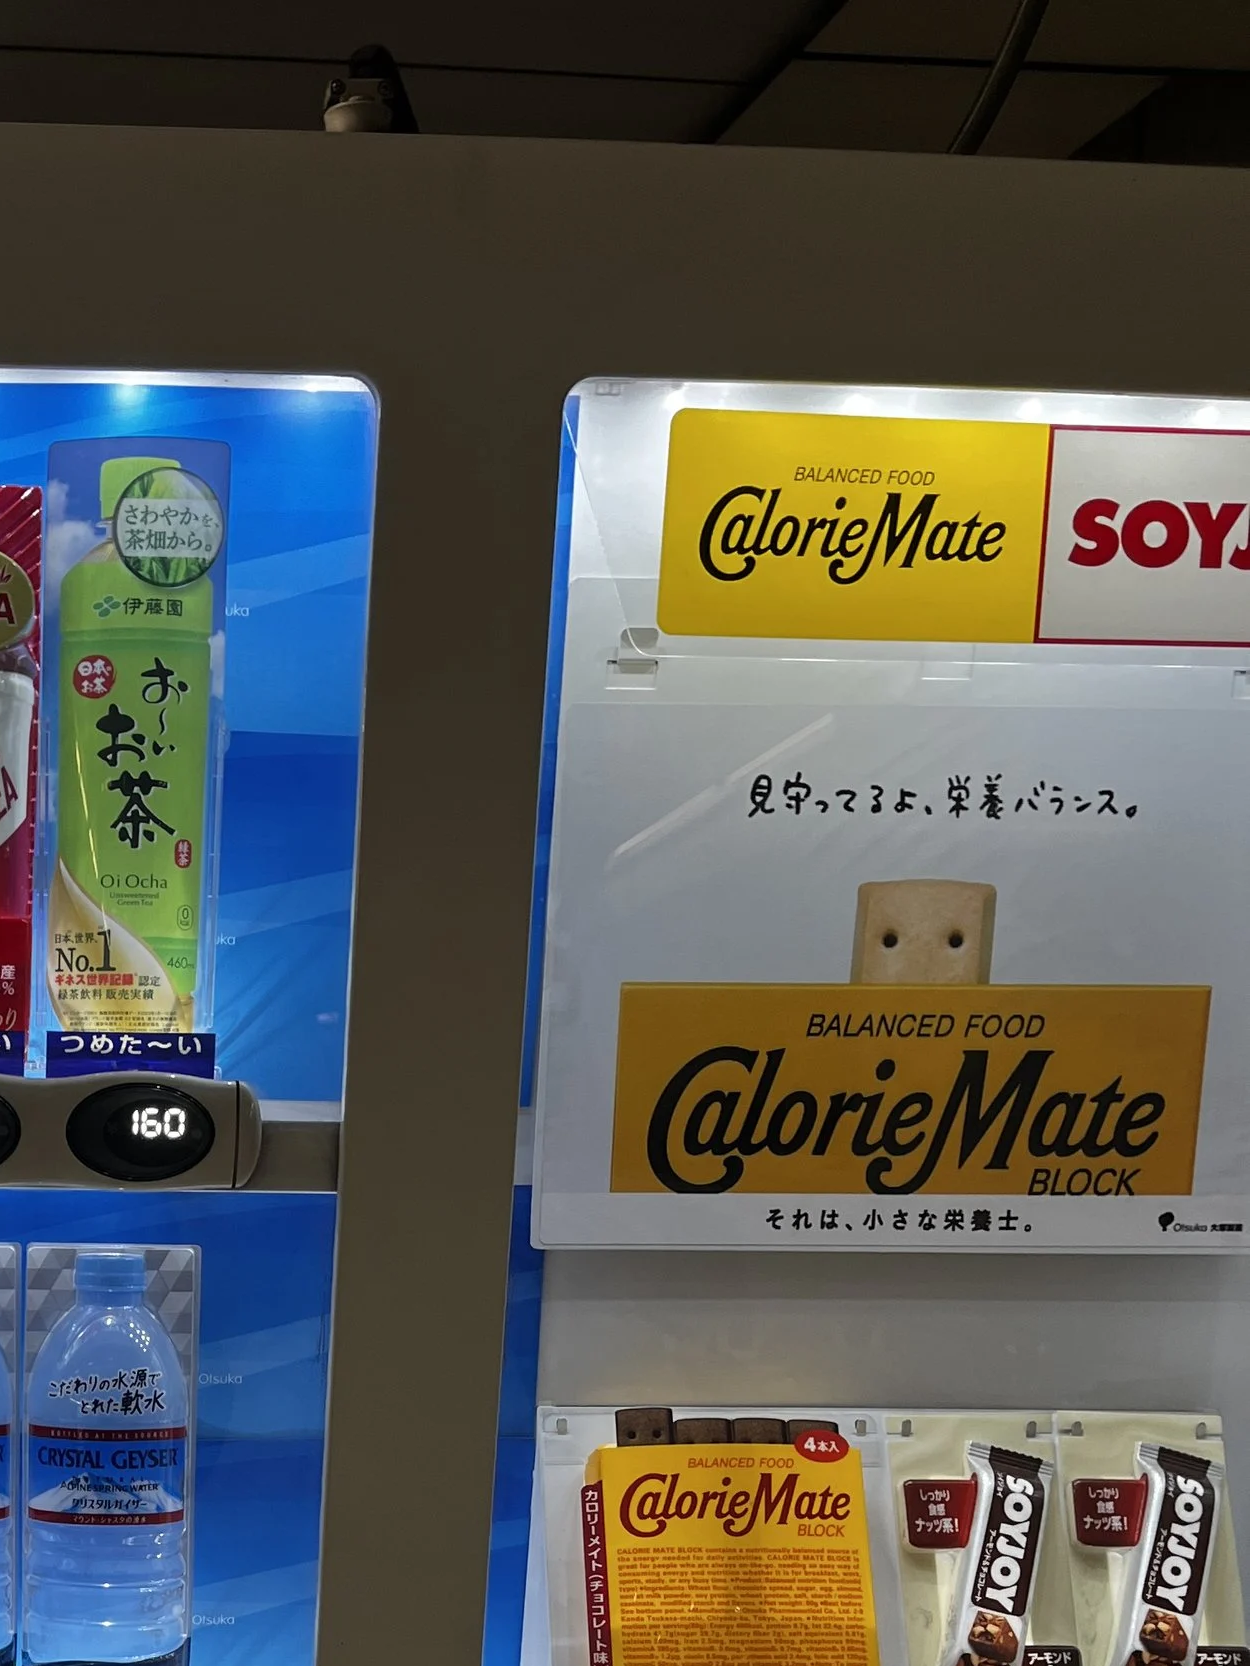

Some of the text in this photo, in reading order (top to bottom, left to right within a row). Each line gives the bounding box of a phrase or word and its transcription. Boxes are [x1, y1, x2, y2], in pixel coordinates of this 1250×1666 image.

[794, 465, 936, 487] BALANCED FOOD
[124, 528, 213, 552] 茶畑から。
[699, 485, 1007, 585] CalorieMate
[123, 597, 184, 617] 伊藤園
[748, 771, 1139, 822] 見守ってるよ、栄養バランス。
[100, 873, 168, 889] Oi Ocha
[806, 1013, 1046, 1039] BALANCED FOOD
[131, 1107, 186, 1140] 160
[646, 1046, 1167, 1196] CalorieMate
[1027, 1167, 1142, 1197] BLOCK
[766, 1208, 1034, 1234] それは、小さな栄養士。
[36, 1446, 179, 1471] CRYSTAL GEYSER
[687, 1457, 796, 1470] BALANCED FOOD
[618, 1472, 852, 1538] CalorieMate
[918, 1488, 950, 1502] しっかり
[796, 1523, 847, 1538] BLOCK
[1027, 1651, 1072, 1666] アーモンド
